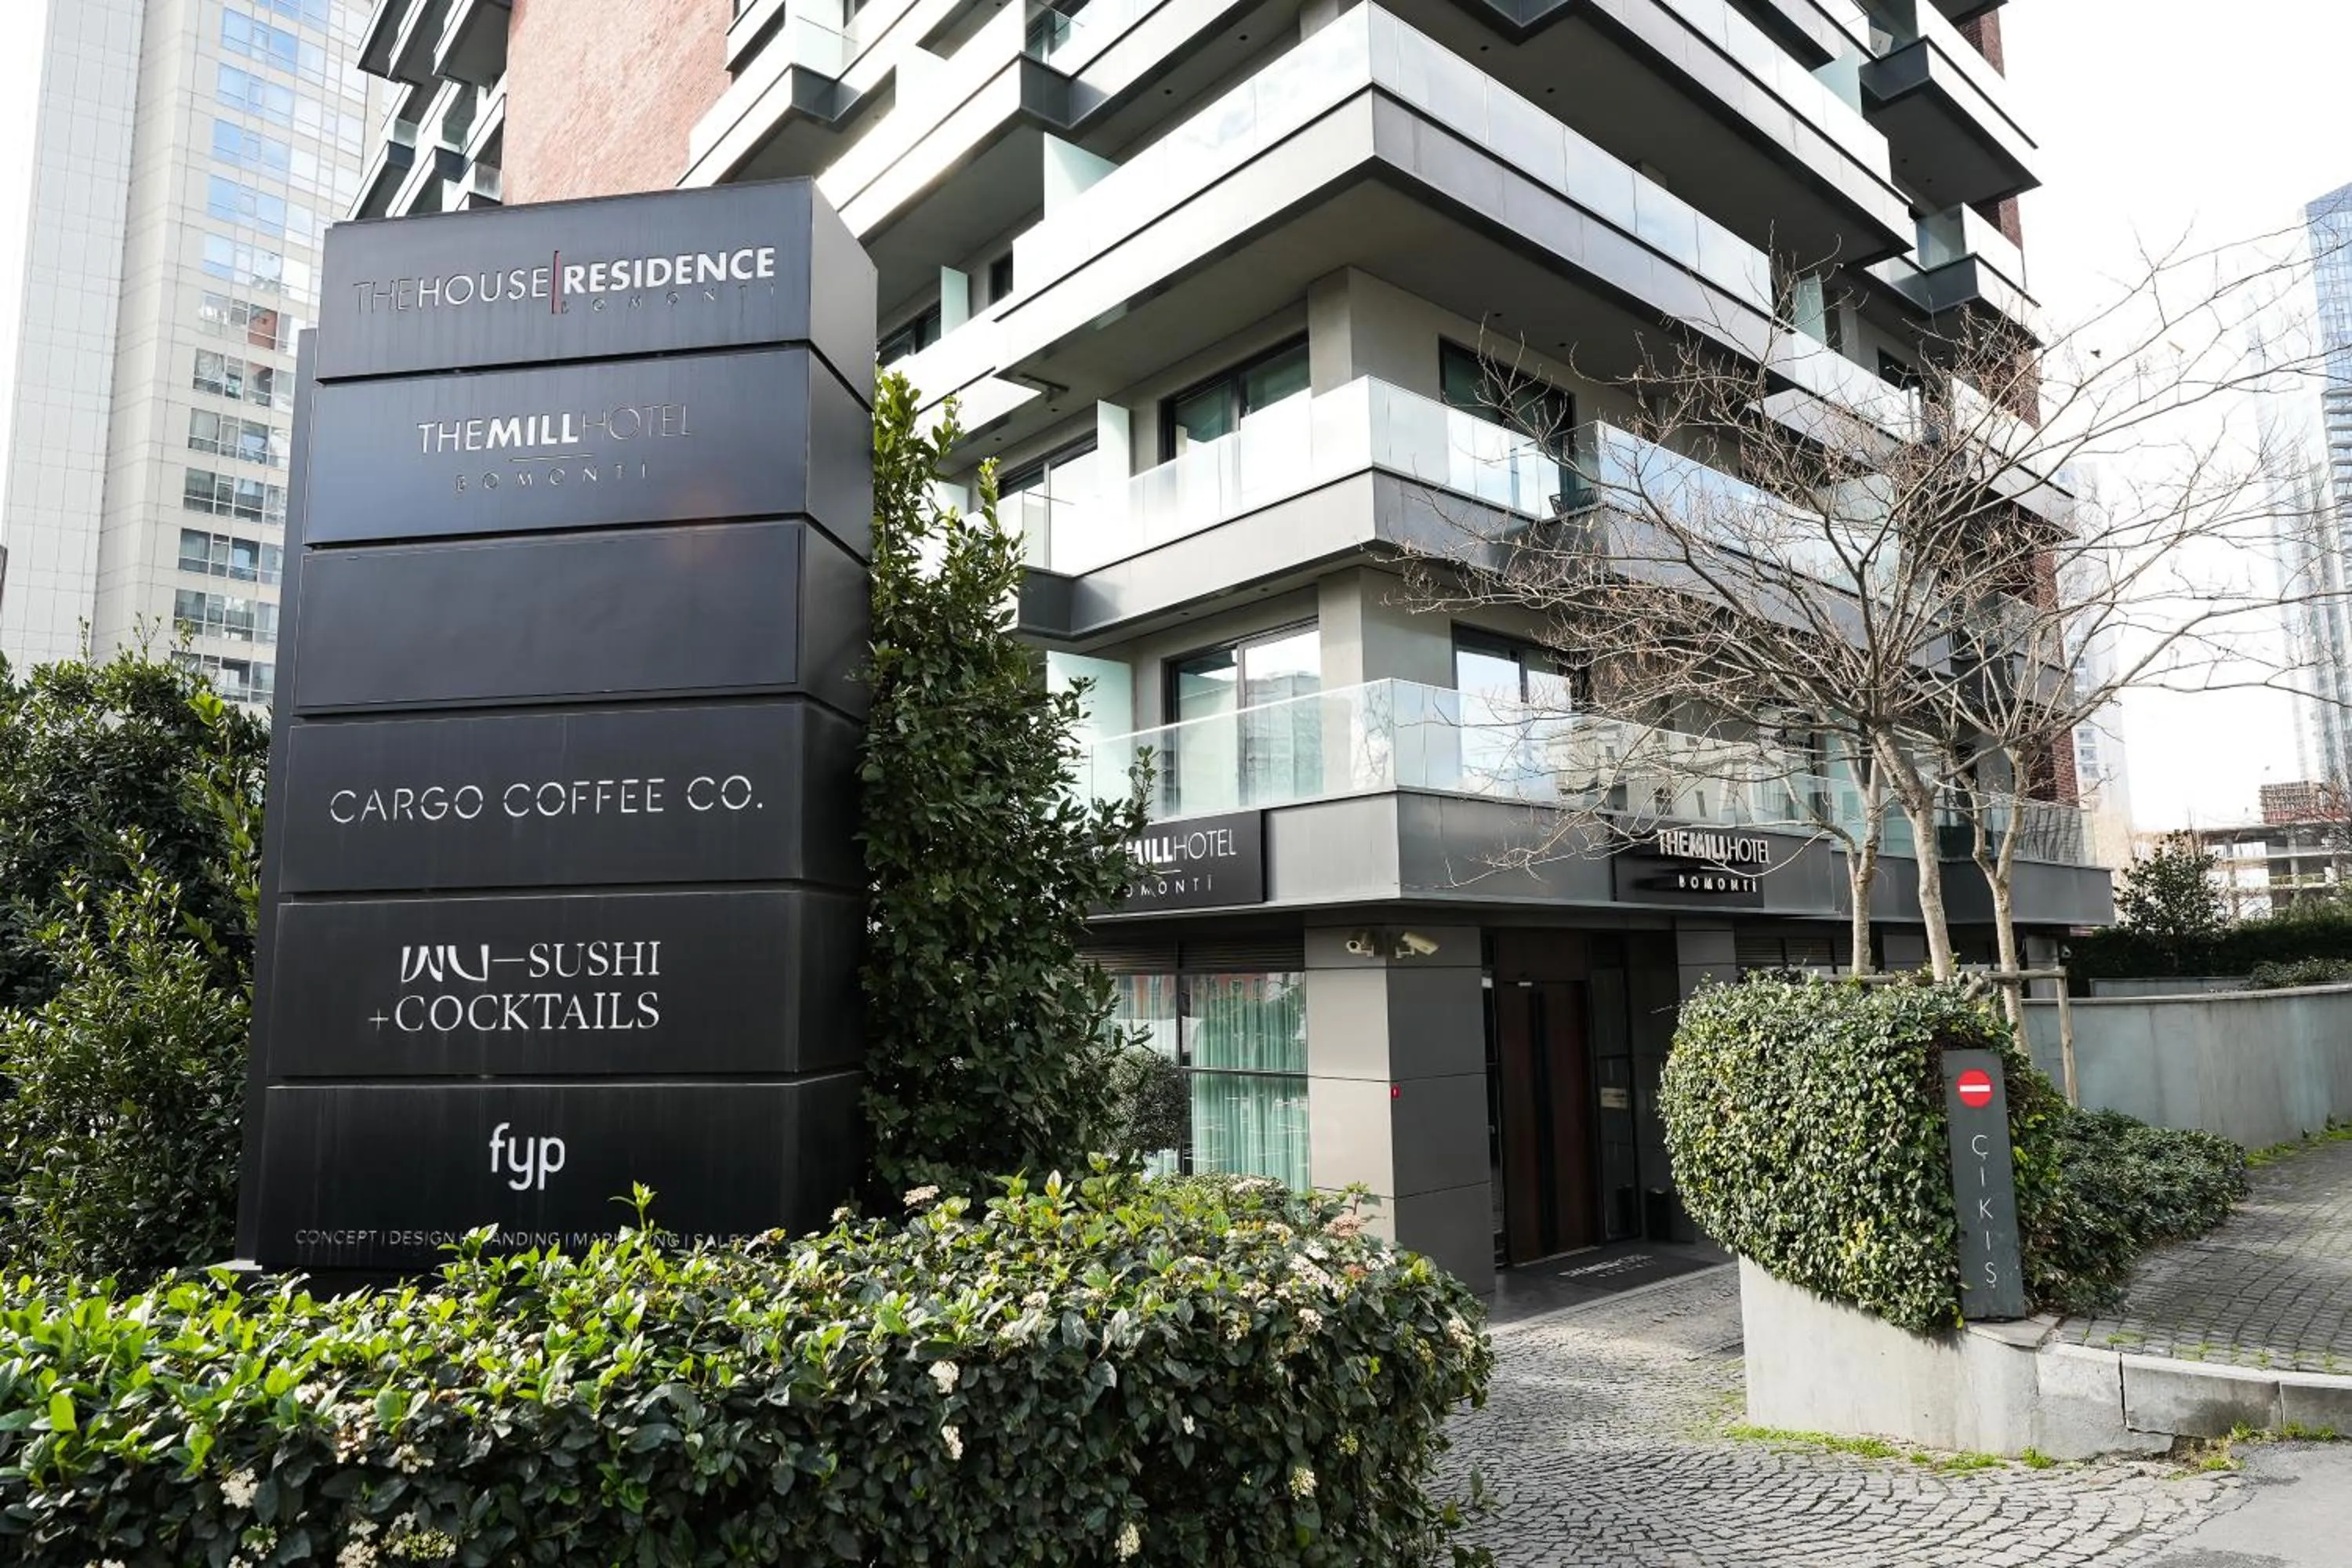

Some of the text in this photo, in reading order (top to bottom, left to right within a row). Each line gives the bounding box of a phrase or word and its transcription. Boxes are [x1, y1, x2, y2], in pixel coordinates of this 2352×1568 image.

[562, 246, 775, 296] RESIDENCE
[455, 463, 648, 492] BOMONTI
[330, 775, 764, 823] CARGO COFFEE CO.
[1678, 874, 1757, 893] BOMONTI
[489, 1122, 565, 1191] fyp
[1971, 1134, 1998, 1289] ÇIKIŞ
[295, 1229, 376, 1245] CONCEPT
[390, 1230, 455, 1246] DESIGN
